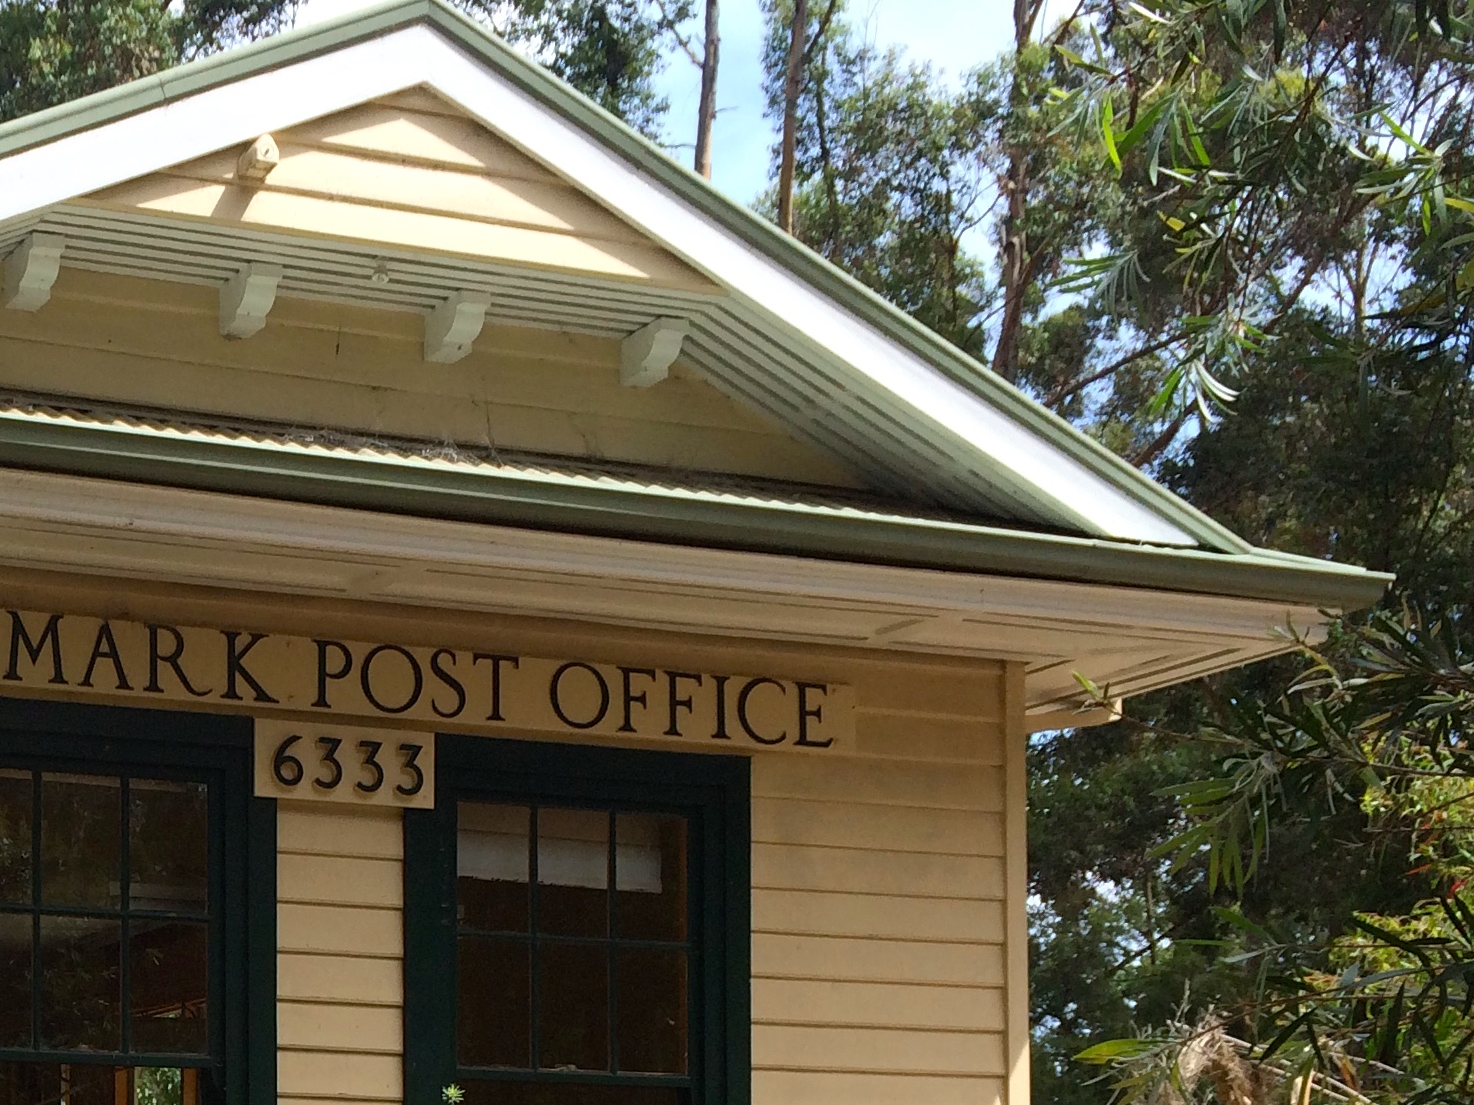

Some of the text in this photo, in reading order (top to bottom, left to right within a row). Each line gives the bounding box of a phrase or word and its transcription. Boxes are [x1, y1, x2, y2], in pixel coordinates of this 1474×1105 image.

[310, 637, 519, 722] POST
[549, 660, 835, 749] OFFICE
[272, 735, 424, 796] 6333
